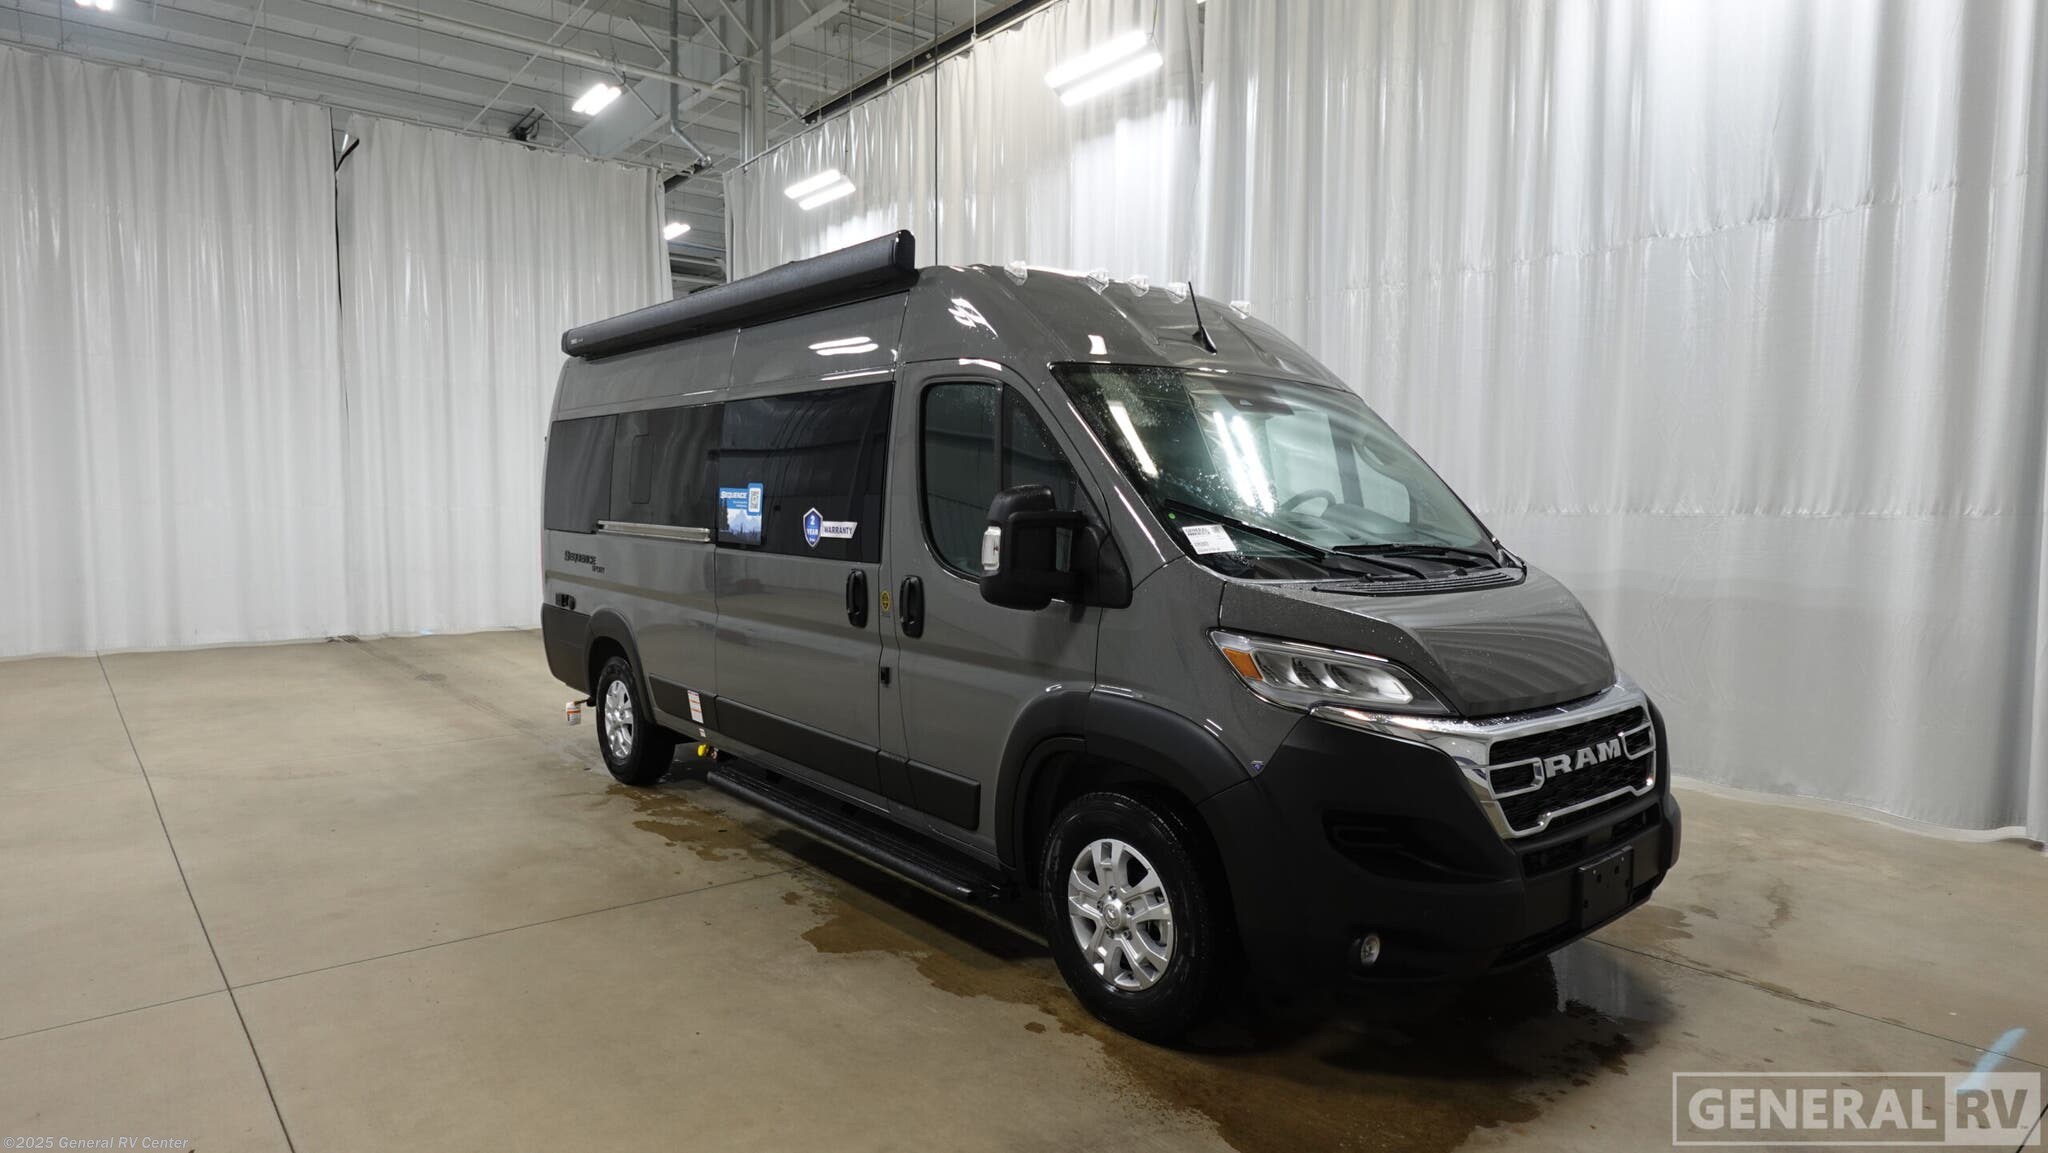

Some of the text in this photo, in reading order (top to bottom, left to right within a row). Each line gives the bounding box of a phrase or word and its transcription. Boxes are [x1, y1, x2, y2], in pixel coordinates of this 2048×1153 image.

[810, 515, 816, 525] 2
[806, 528, 819, 536] YEAR
[824, 526, 853, 535] WARRANTY
[1543, 738, 1622, 779] RAM
